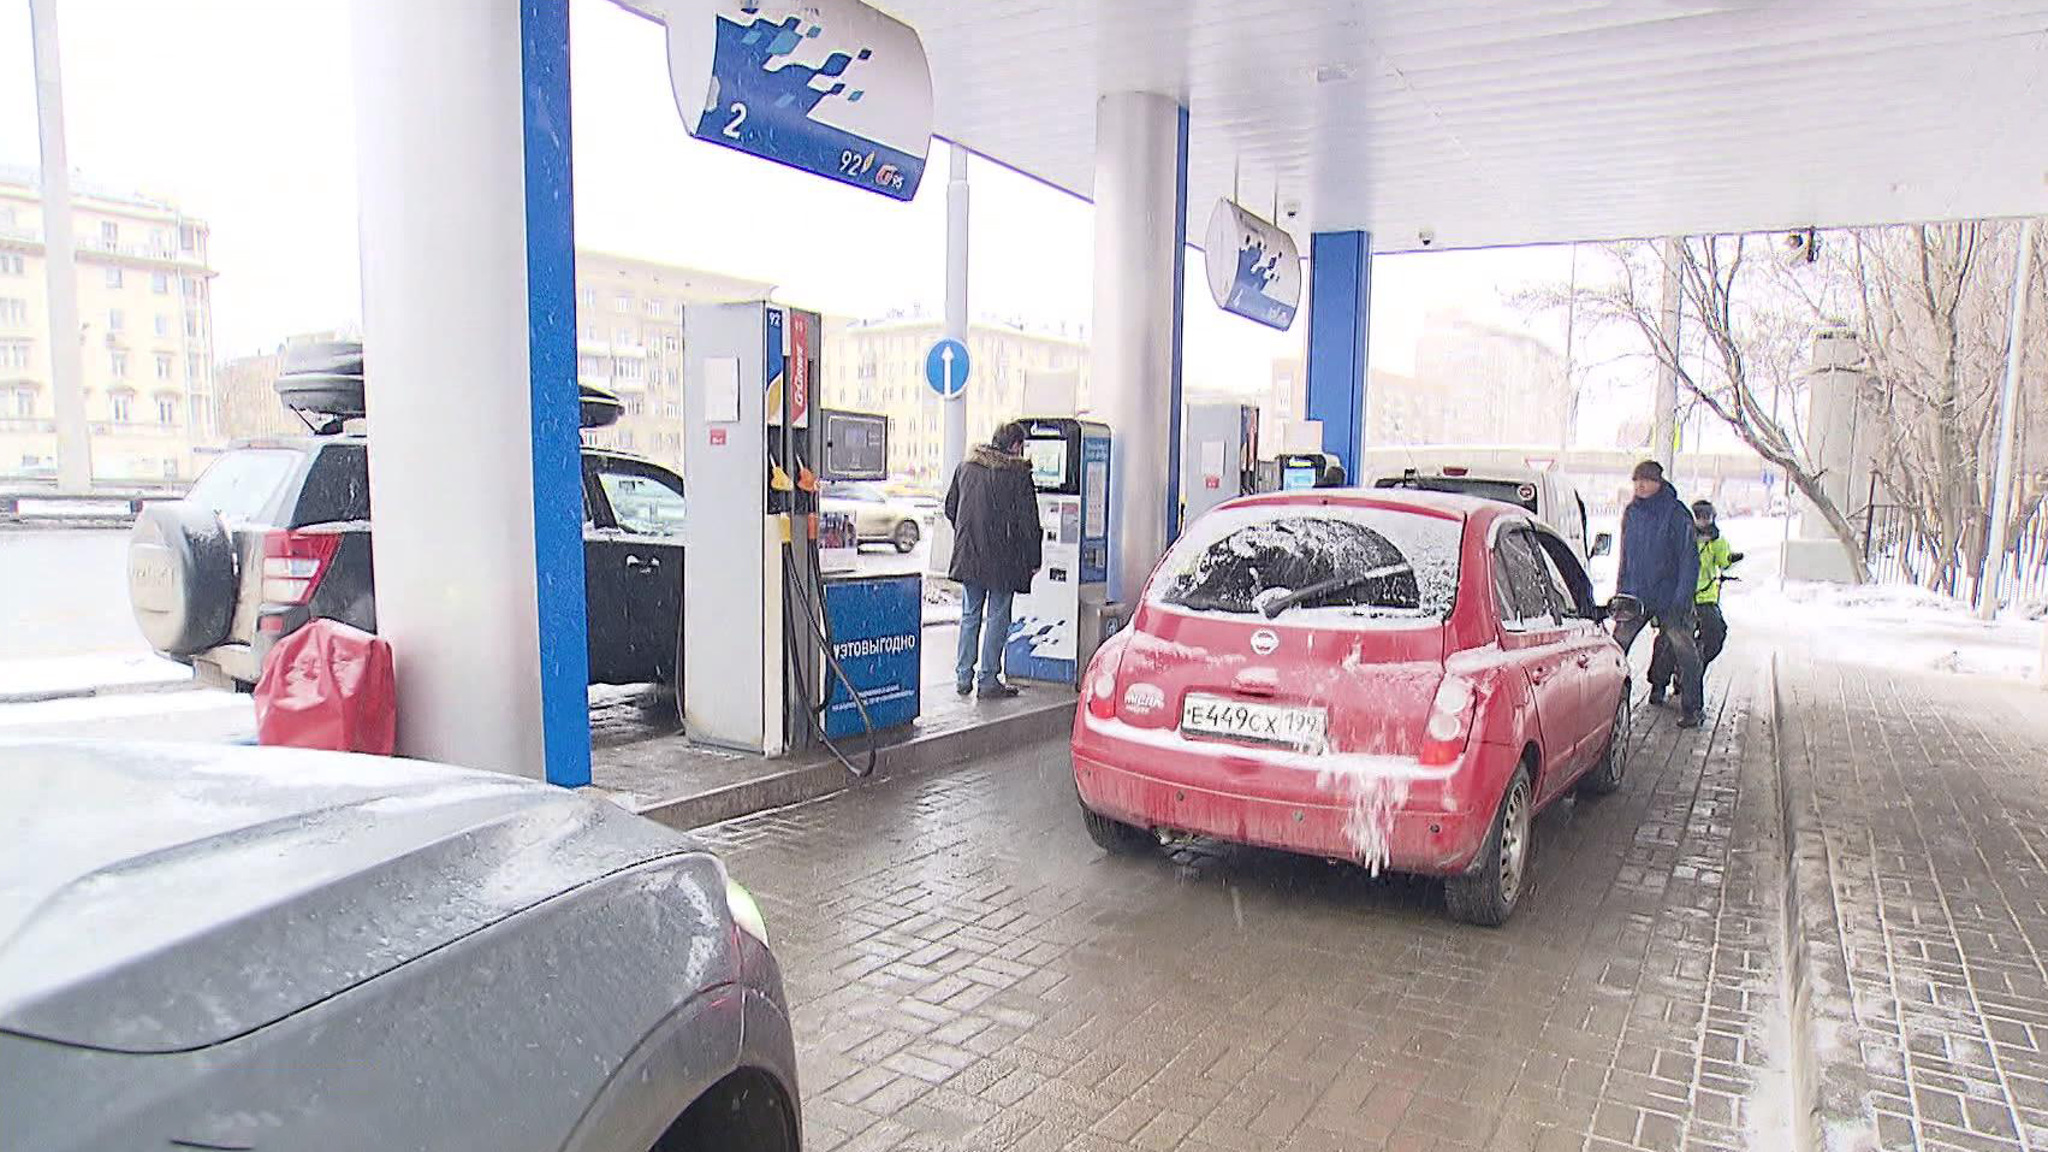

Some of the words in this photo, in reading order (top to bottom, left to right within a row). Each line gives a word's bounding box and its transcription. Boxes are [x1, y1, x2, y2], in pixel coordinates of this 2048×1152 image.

[723, 102, 748, 139] 2
[839, 150, 863, 176] 92
[769, 311, 782, 328] 92
